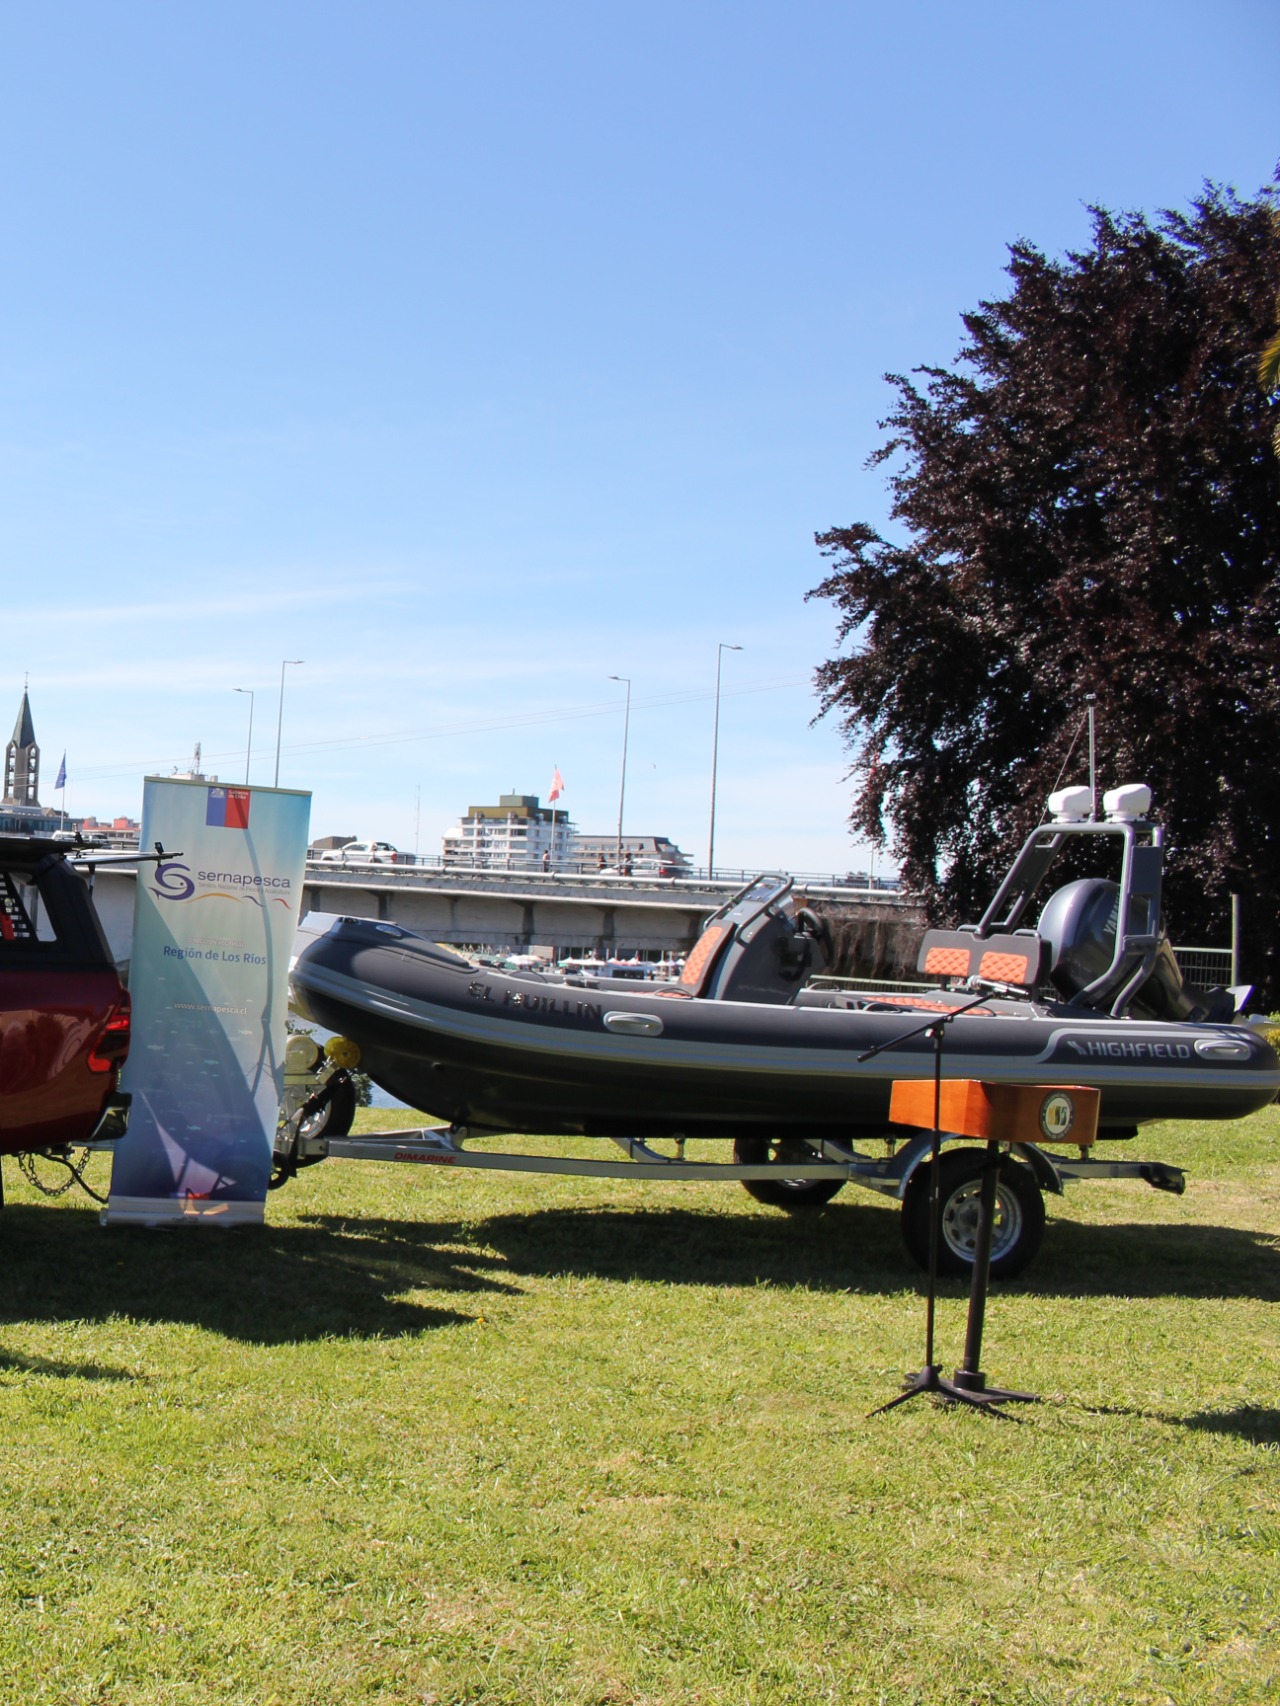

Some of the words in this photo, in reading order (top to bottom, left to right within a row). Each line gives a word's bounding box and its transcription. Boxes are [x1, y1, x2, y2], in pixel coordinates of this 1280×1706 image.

[197, 871, 291, 889] sernapesca
[163, 945, 202, 960] Región
[205, 950, 219, 961] de
[222, 951, 240, 963] Los
[243, 952, 266, 965] Ríos
[174, 1002, 248, 1015] www.sernapesca.cl
[1087, 1041, 1191, 1059] HIGHFIELD
[394, 1152, 457, 1164] DIMARINE
